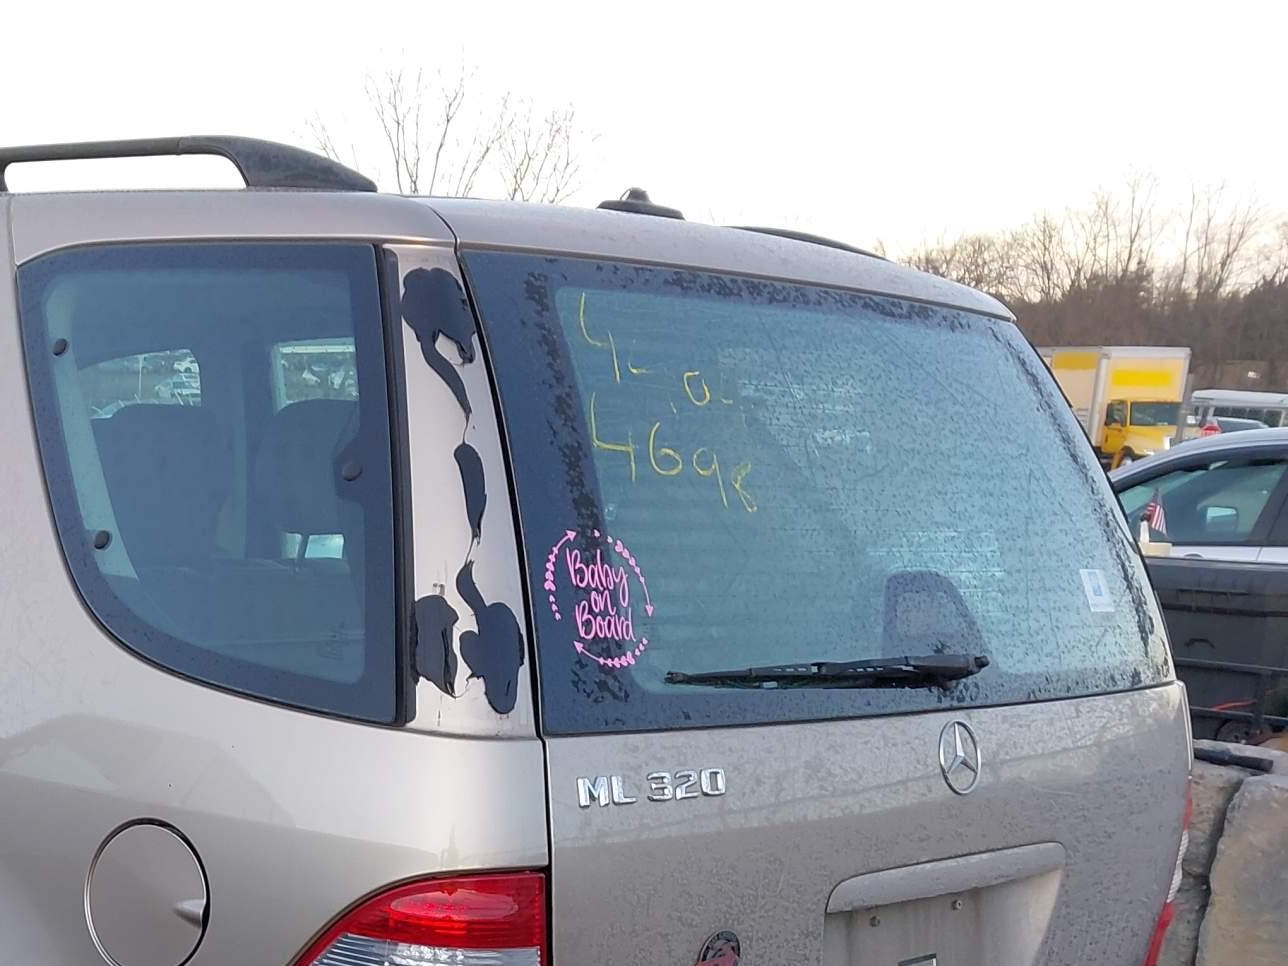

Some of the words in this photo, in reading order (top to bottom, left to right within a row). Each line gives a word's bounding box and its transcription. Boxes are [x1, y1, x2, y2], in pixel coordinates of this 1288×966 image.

[588, 391, 758, 512] 4698
[566, 547, 629, 607] Baby
[575, 600, 637, 642] Board
[591, 590, 617, 615] on
[577, 775, 637, 808] ML
[647, 768, 726, 802] 320
